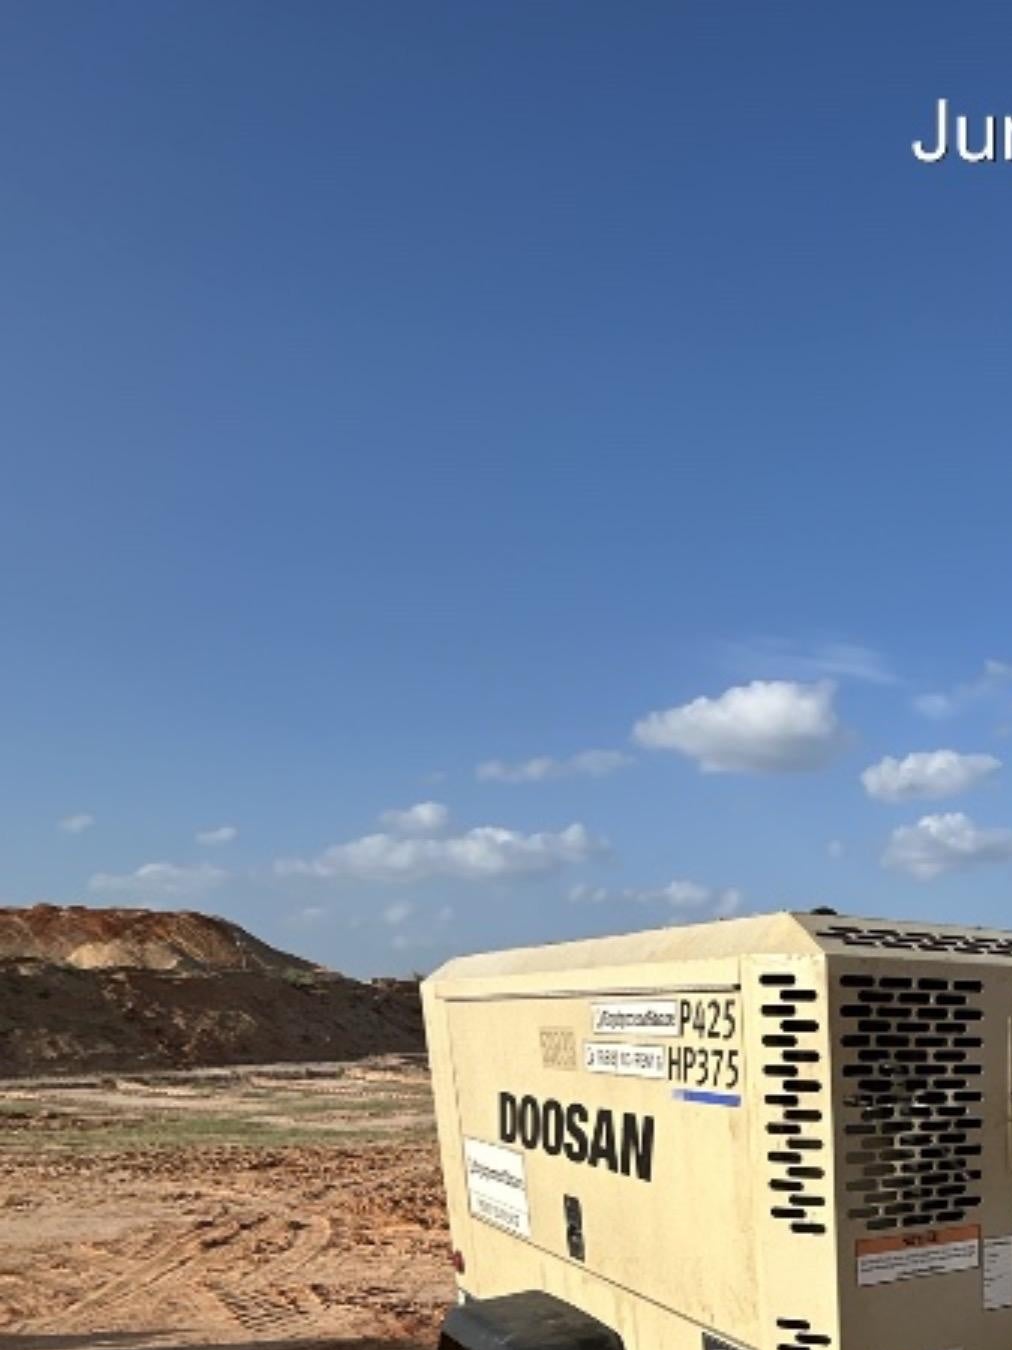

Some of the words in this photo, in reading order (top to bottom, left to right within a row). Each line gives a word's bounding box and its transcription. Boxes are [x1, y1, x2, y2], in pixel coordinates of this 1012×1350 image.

[680, 998, 736, 1041] P425
[668, 1046, 739, 1089] HP375
[498, 1090, 655, 1183] DOOSAN
